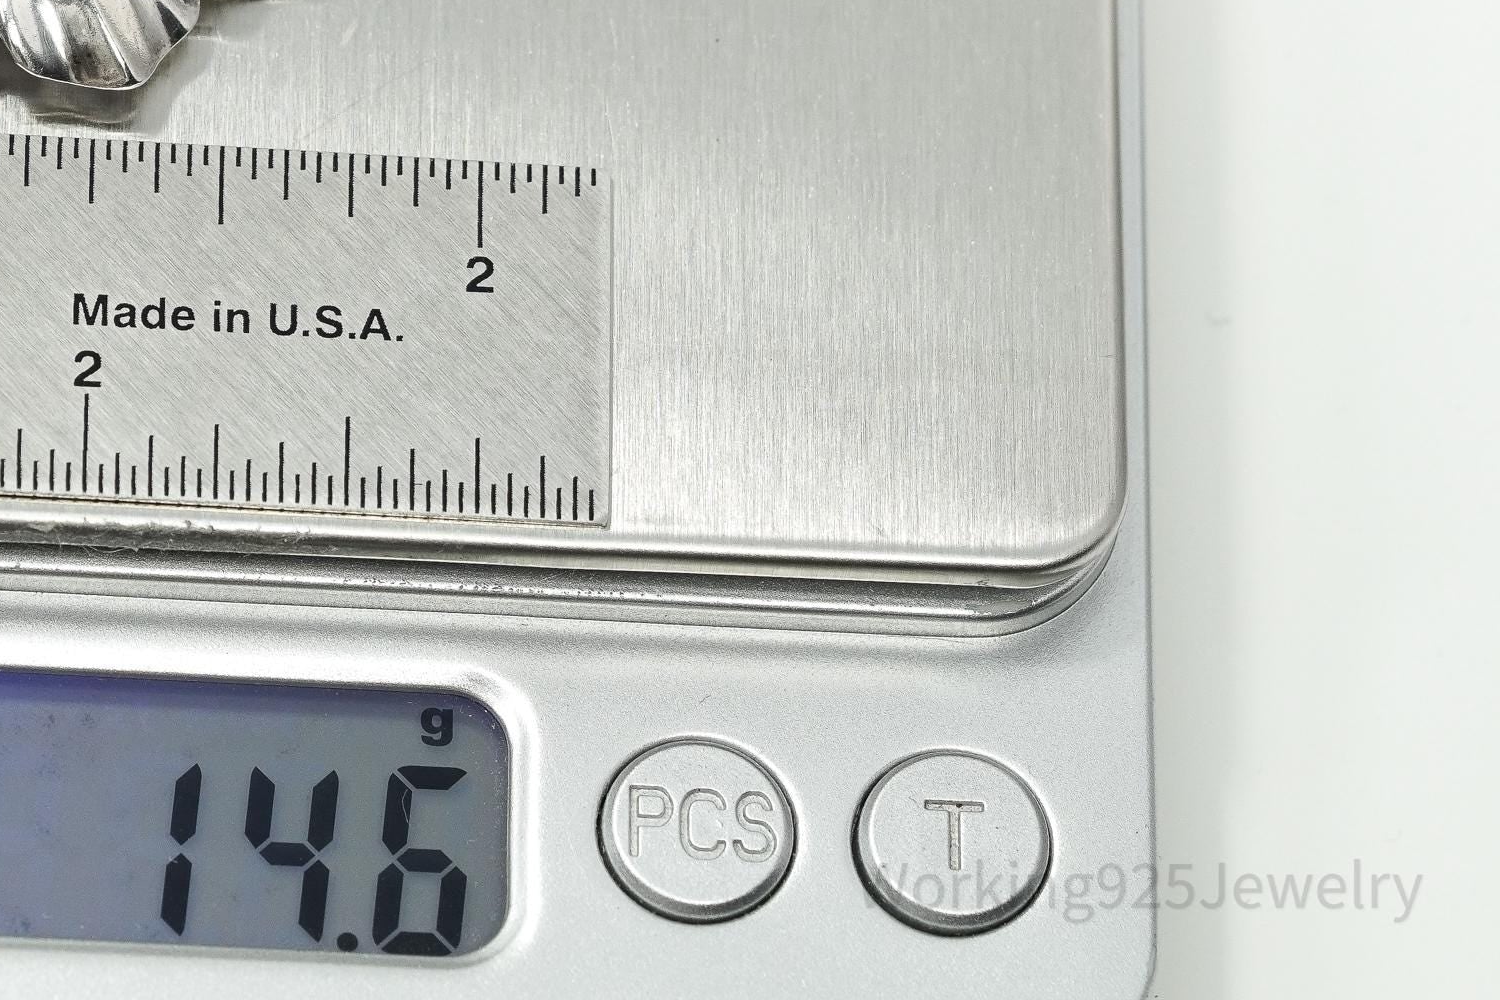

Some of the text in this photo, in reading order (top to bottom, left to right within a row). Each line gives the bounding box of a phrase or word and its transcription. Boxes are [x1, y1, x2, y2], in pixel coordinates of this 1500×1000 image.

[464, 254, 496, 295] 2
[71, 291, 405, 343] Made in U.S.A.
[72, 349, 103, 389] 2
[419, 706, 455, 747] g
[627, 782, 781, 864] PCS
[922, 798, 986, 872] T
[160, 762, 470, 957] 14.6
